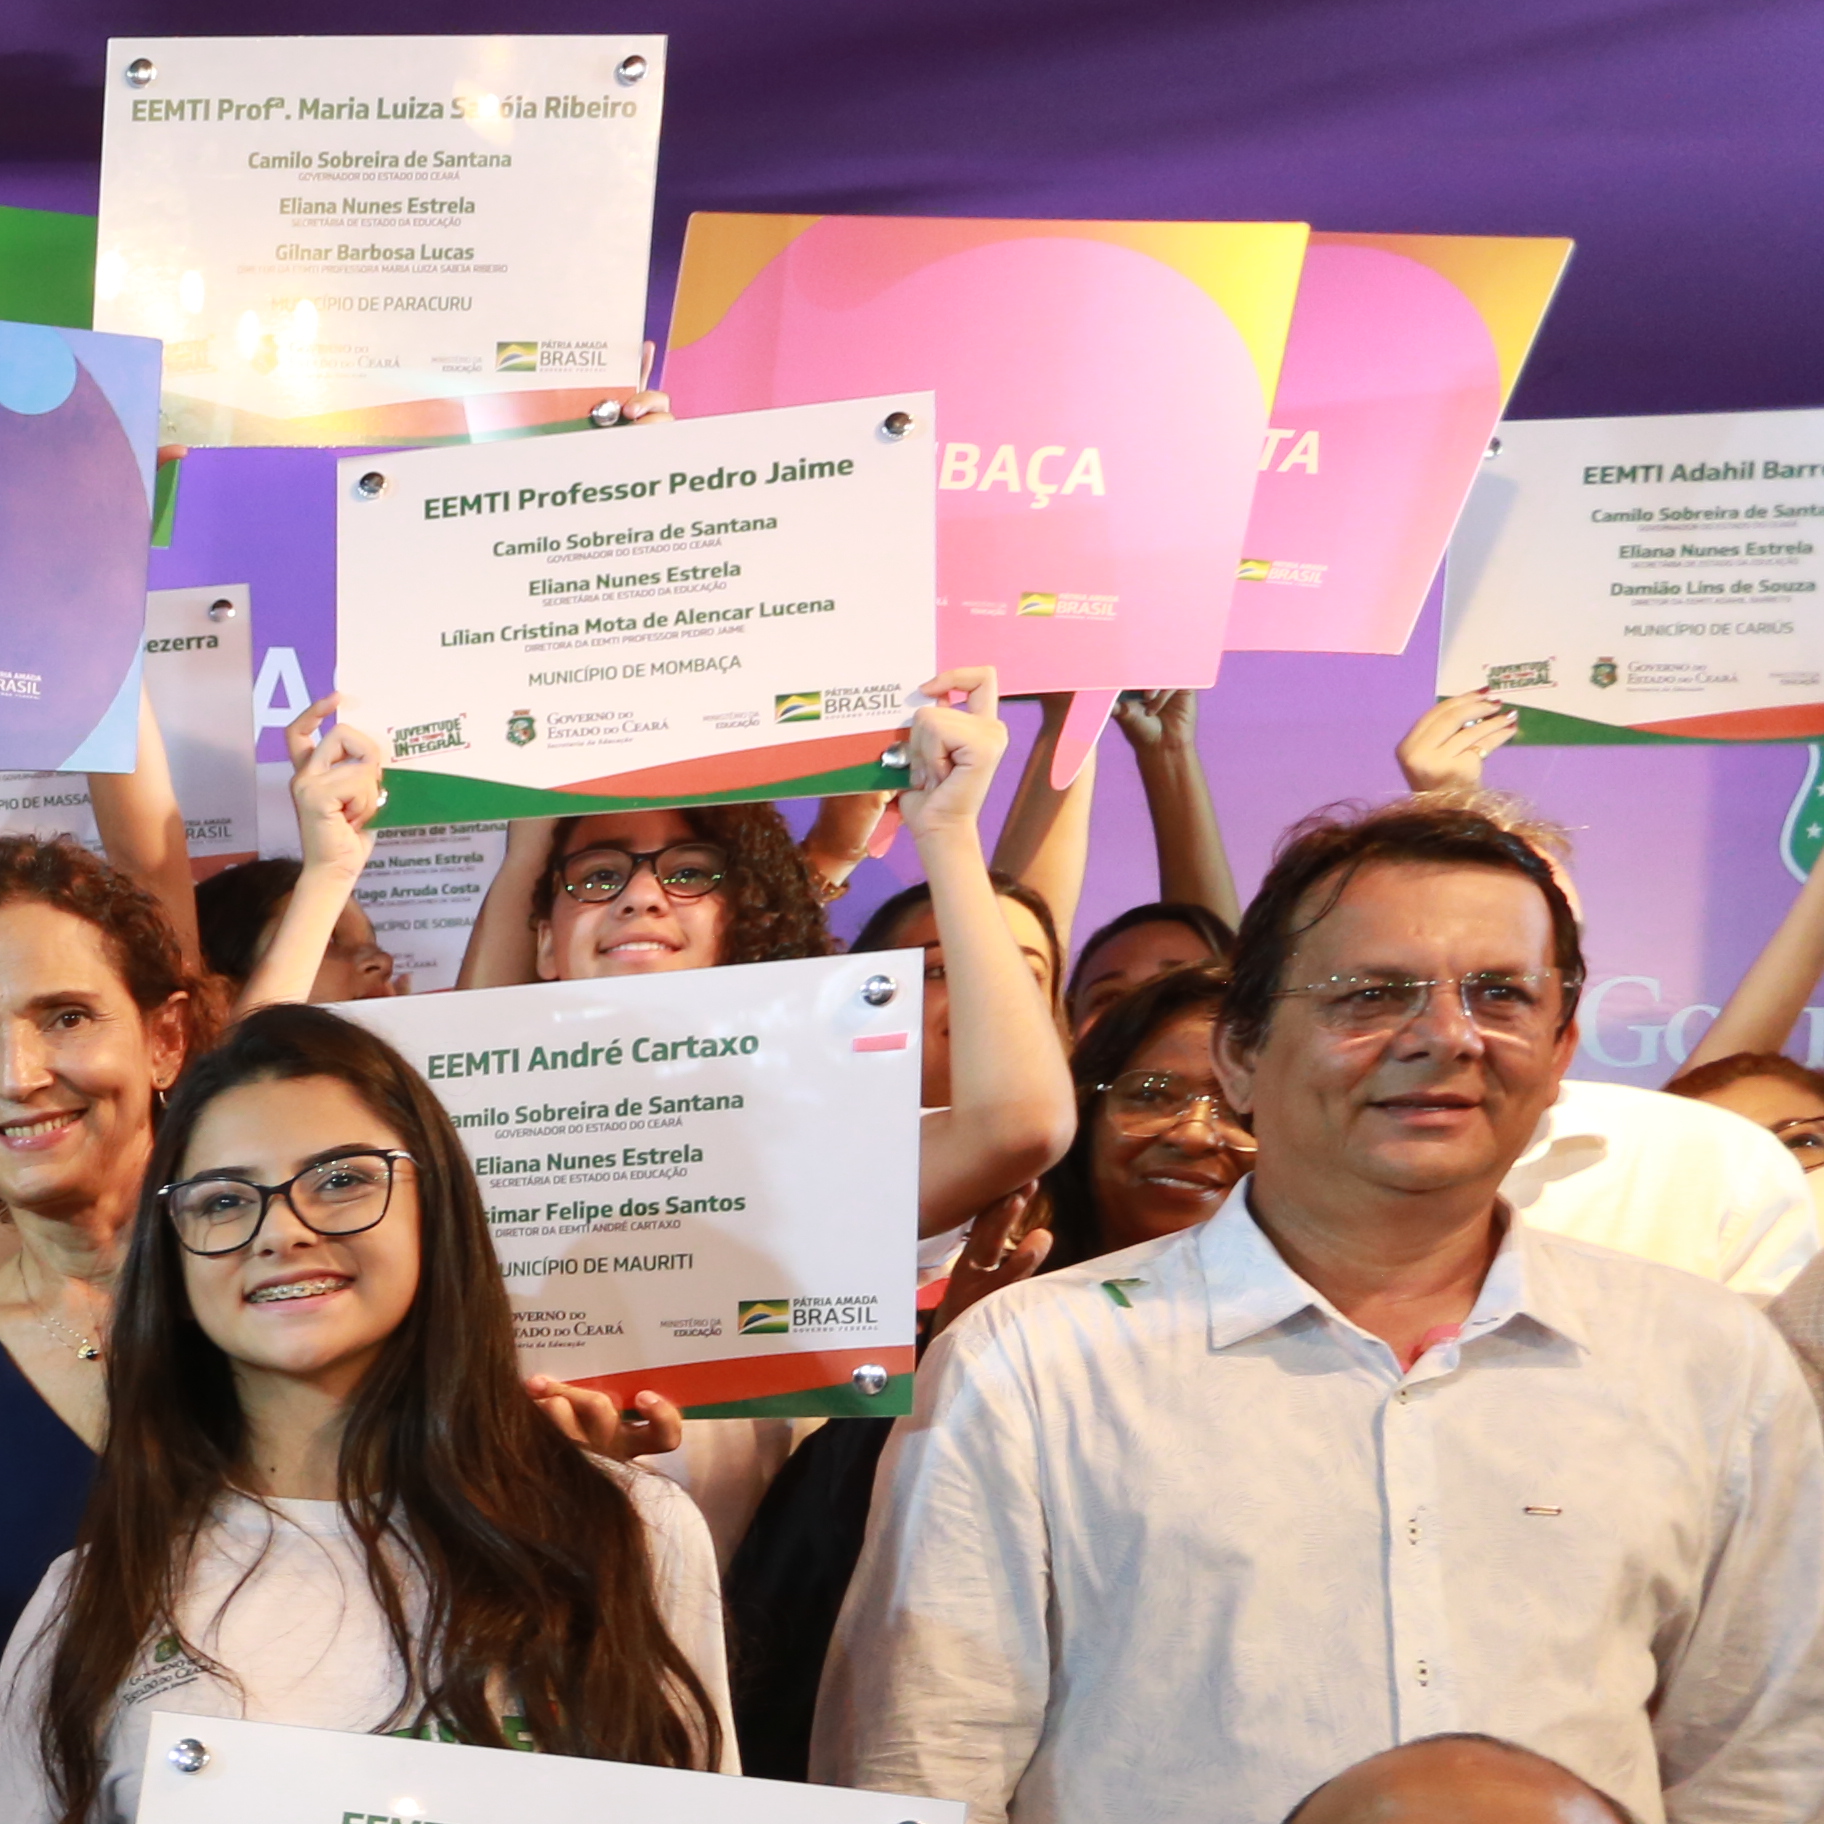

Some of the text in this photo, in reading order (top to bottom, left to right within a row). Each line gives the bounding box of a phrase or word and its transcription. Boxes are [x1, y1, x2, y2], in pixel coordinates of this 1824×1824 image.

[132, 99, 210, 121] EEMTI
[298, 96, 369, 120] Maria
[377, 96, 443, 120] Luiza
[544, 95, 637, 119] Ribeiro
[276, 243, 474, 261] Gilnar Barbosa Lucas
[358, 296, 472, 311] DE PARACURU
[938, 441, 1108, 509] BAÇA
[1583, 464, 1663, 485] EEMTI
[1670, 461, 1755, 482] Adahil
[425, 458, 854, 520] EEMTI Professor Pedro Jaime
[441, 599, 835, 647] Lílian Cristina Mota de Alencar Lucena
[529, 655, 742, 686] MUNICÍPIO DE MOMBAÇA
[440, 882, 481, 896] Costa
[428, 1035, 759, 1080] EEMTI André Cartaxo
[500, 1254, 693, 1279] UNICÍPIO DE MAURITI
